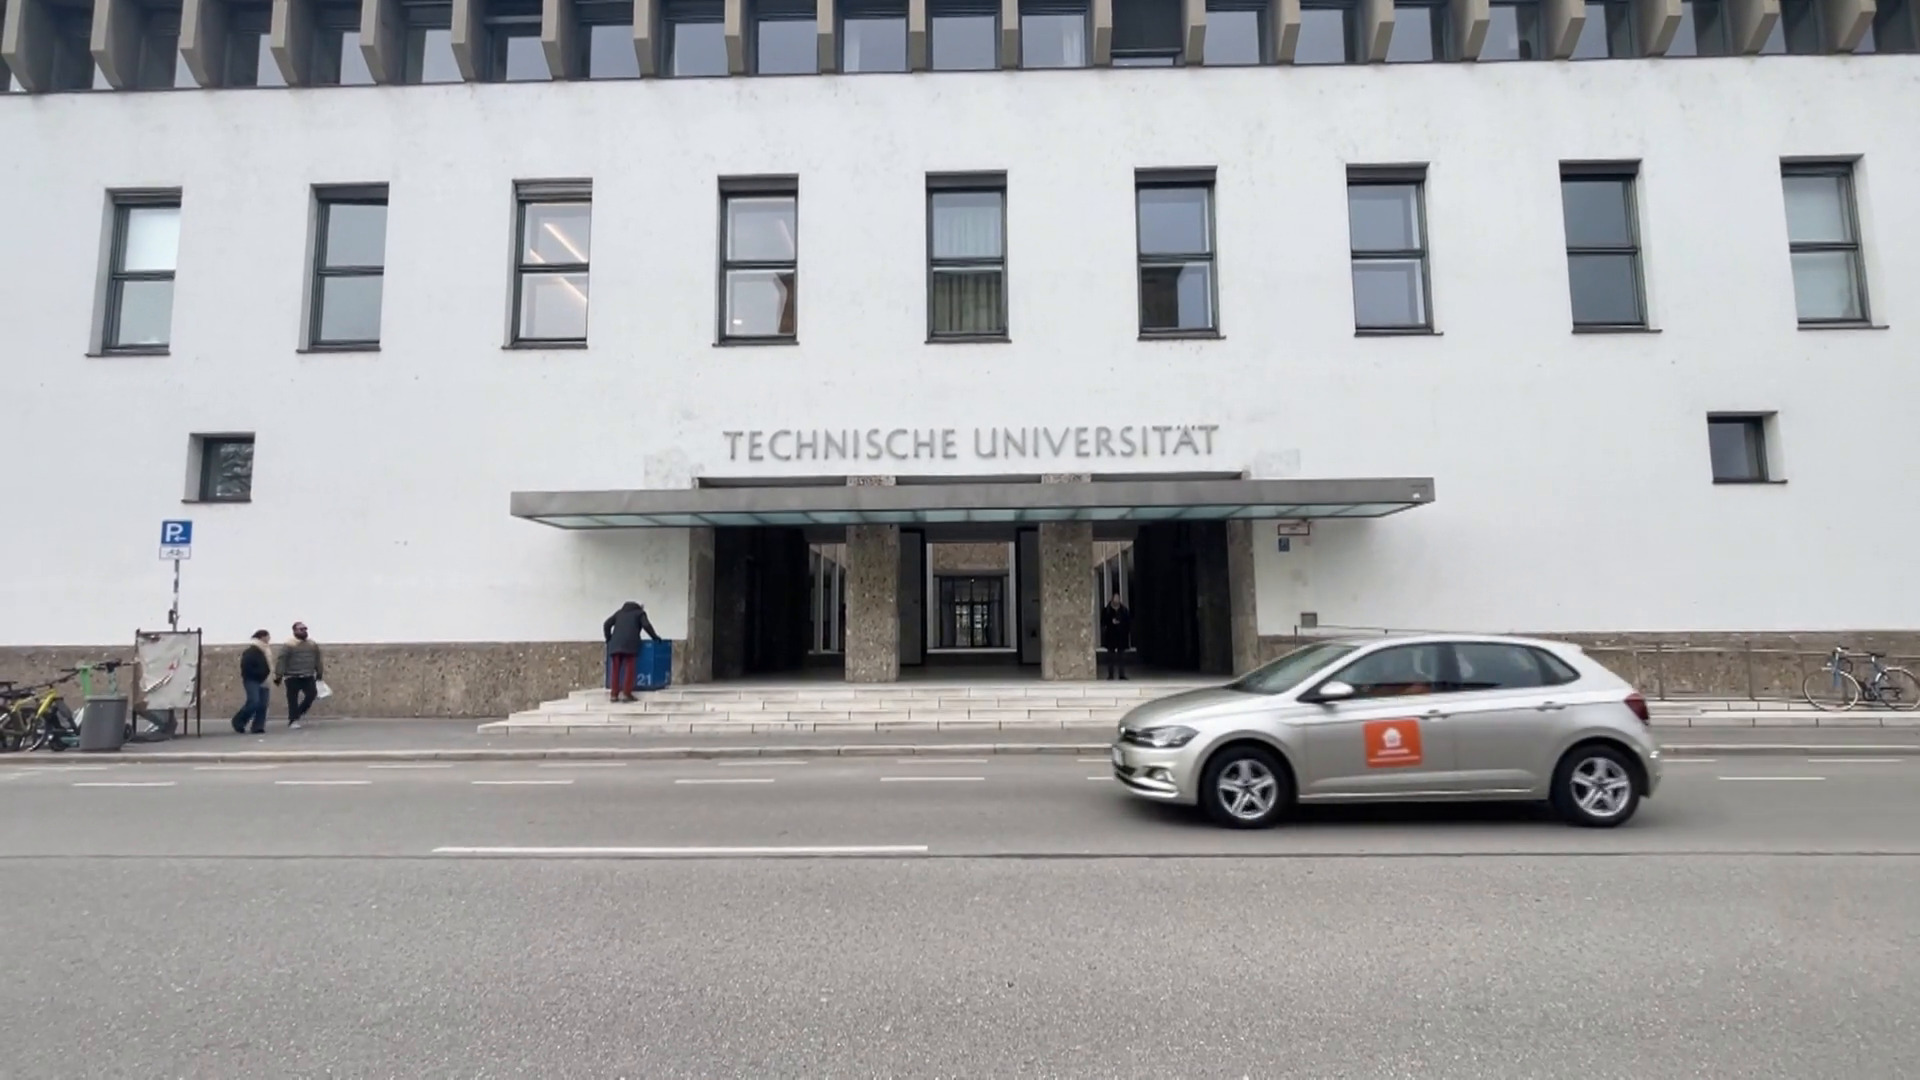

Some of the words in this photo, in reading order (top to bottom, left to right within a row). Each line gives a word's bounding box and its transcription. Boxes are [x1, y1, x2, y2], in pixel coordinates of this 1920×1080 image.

[723, 428, 957, 462] TECHNISCHE
[974, 425, 1220, 459] UNIVERSITÄT
[165, 523, 184, 542] P
[637, 673, 652, 686] 21
